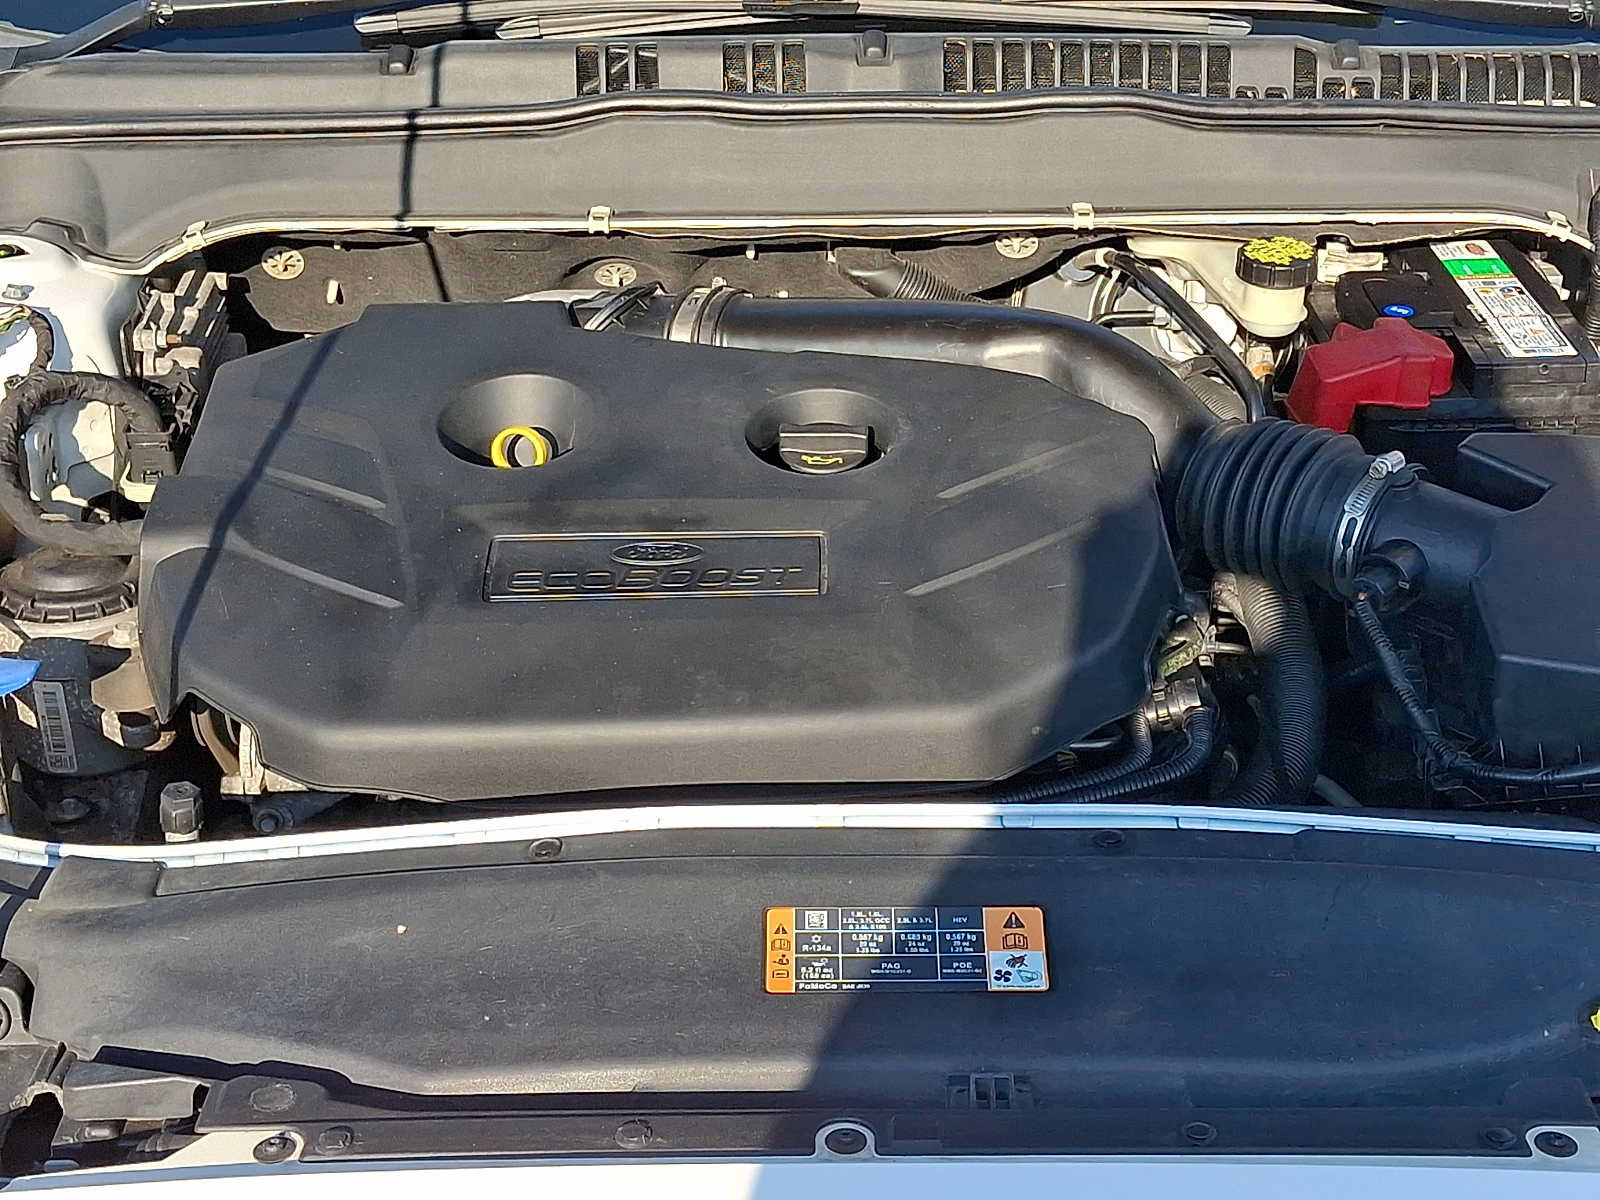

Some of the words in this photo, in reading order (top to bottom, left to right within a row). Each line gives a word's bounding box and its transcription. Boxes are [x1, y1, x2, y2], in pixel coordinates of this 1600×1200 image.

[508, 568, 803, 592] ECOBOOST
[922, 933, 932, 942] kg
[966, 933, 977, 941] kg
[802, 944, 832, 952] R-134a
